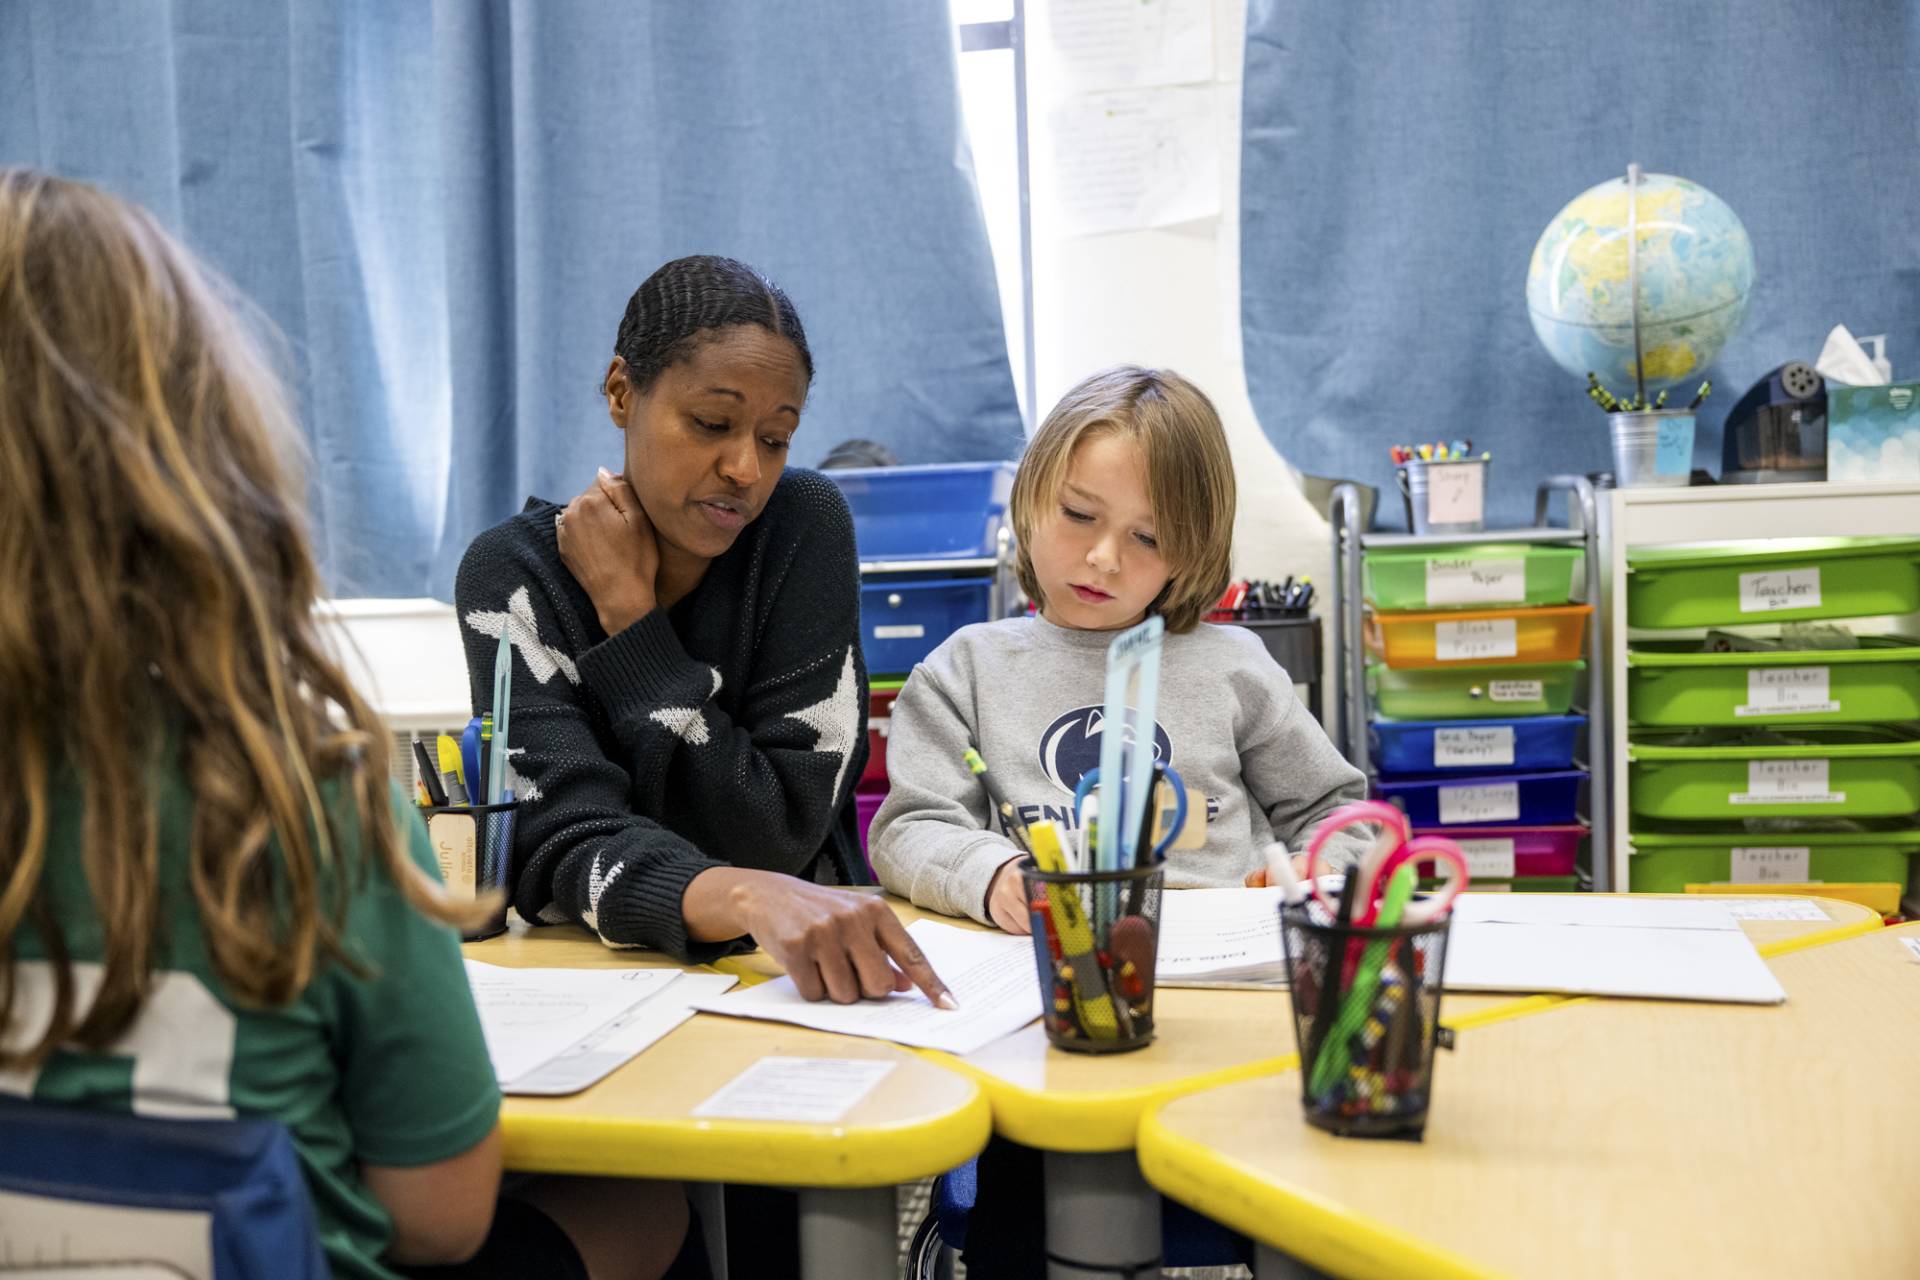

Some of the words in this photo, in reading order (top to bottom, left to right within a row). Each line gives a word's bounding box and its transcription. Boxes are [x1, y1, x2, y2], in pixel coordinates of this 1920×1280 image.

[1750, 575, 1813, 599] Teacher
[1758, 669, 1819, 683] Teacher
[1758, 760, 1819, 773] Teacher
[1741, 848, 1800, 862] Teacher
[1759, 866, 1780, 880] Bin
